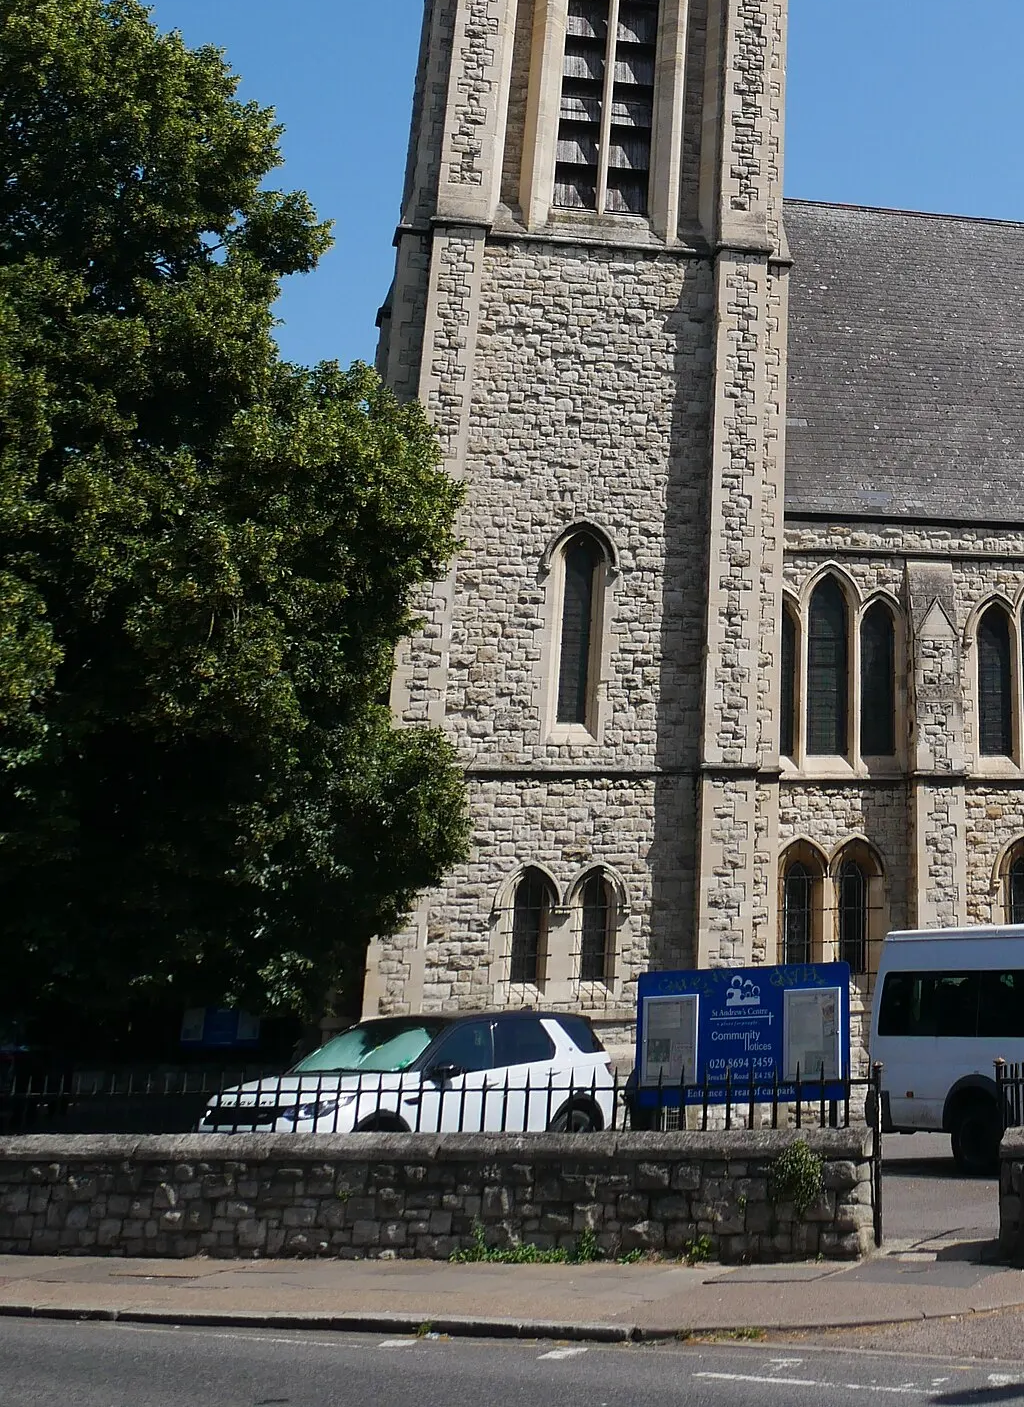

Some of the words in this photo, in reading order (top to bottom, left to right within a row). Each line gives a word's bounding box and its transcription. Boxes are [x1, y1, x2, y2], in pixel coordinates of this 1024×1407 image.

[711, 1009, 718, 1017] St
[719, 1007, 747, 1017] Andrew's
[747, 1007, 769, 1015] Centre
[711, 1030, 761, 1041] Community
[709, 1058, 726, 1069] 020
[728, 1057, 749, 1069] 8694
[752, 1057, 773, 1067] 2459
[733, 1072, 749, 1080] Road
[687, 1089, 722, 1098] Entrnce
[777, 1085, 796, 1097] park
